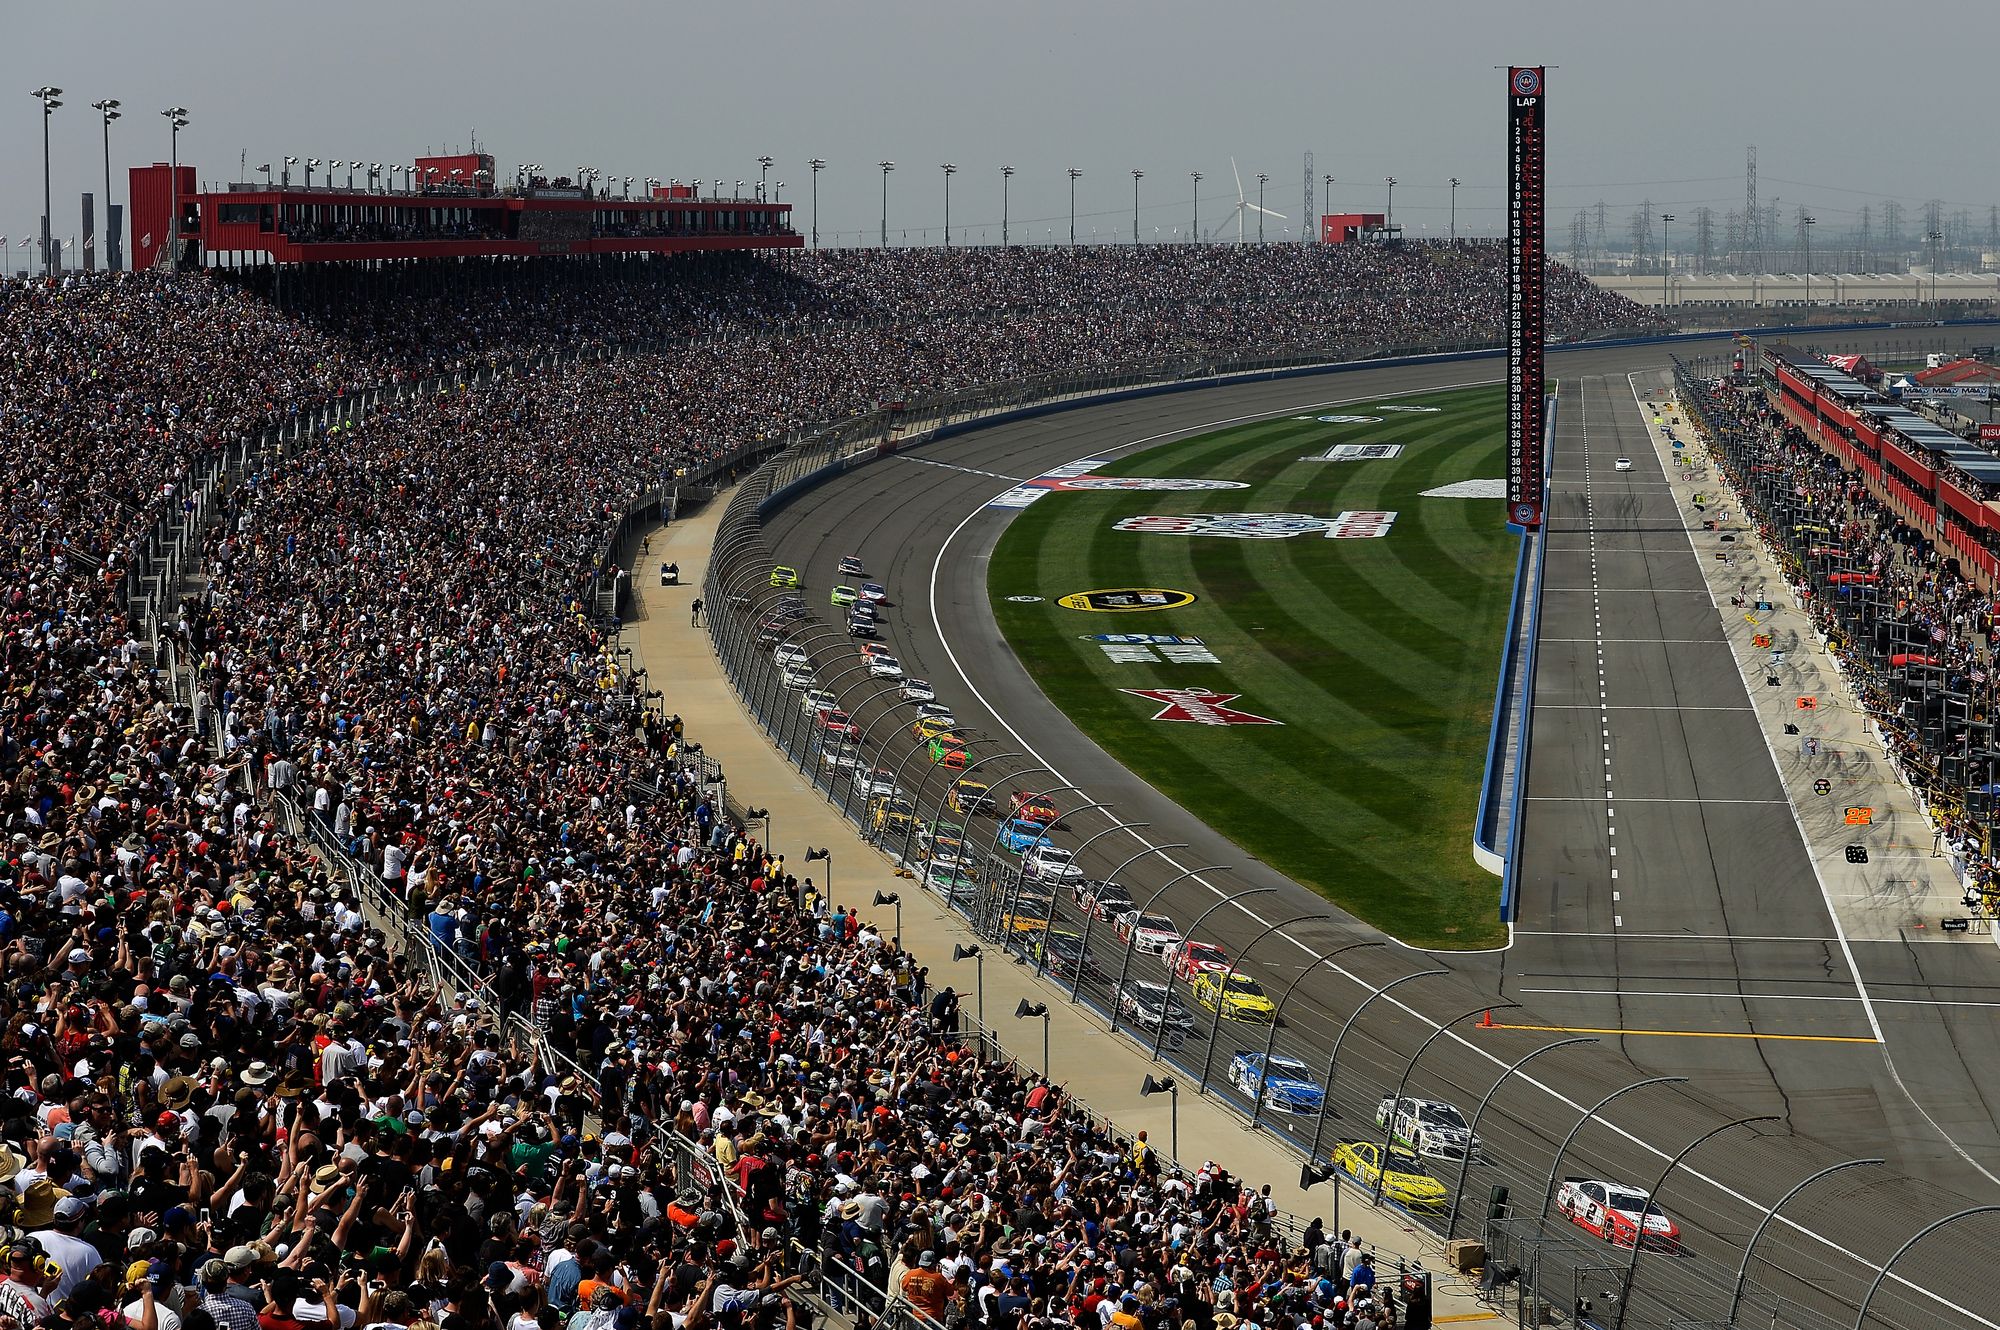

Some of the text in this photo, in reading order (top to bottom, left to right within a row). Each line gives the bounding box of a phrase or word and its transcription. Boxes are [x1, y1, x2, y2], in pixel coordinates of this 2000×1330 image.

[1516, 98, 1536, 106] LAP
[1516, 127, 1520, 135] 2
[1516, 136, 1520, 144] 3
[1516, 164, 1520, 172] 6
[1515, 182, 1520, 190] 8
[1513, 201, 1520, 209] 10
[1513, 247, 1520, 255] 15
[1513, 256, 1520, 264] 16
[1512, 293, 1521, 301] 20
[1512, 302, 1519, 310] 21
[1512, 348, 1521, 356] 26
[1512, 357, 1520, 365] 27
[1512, 366, 1521, 374] 28
[1512, 403, 1520, 411] 32
[1512, 412, 1521, 420] 33
[1512, 421, 1520, 429] 34
[1512, 430, 1521, 438] 35
[1844, 808, 1872, 824] 22
[1586, 1202, 1598, 1220] 2
